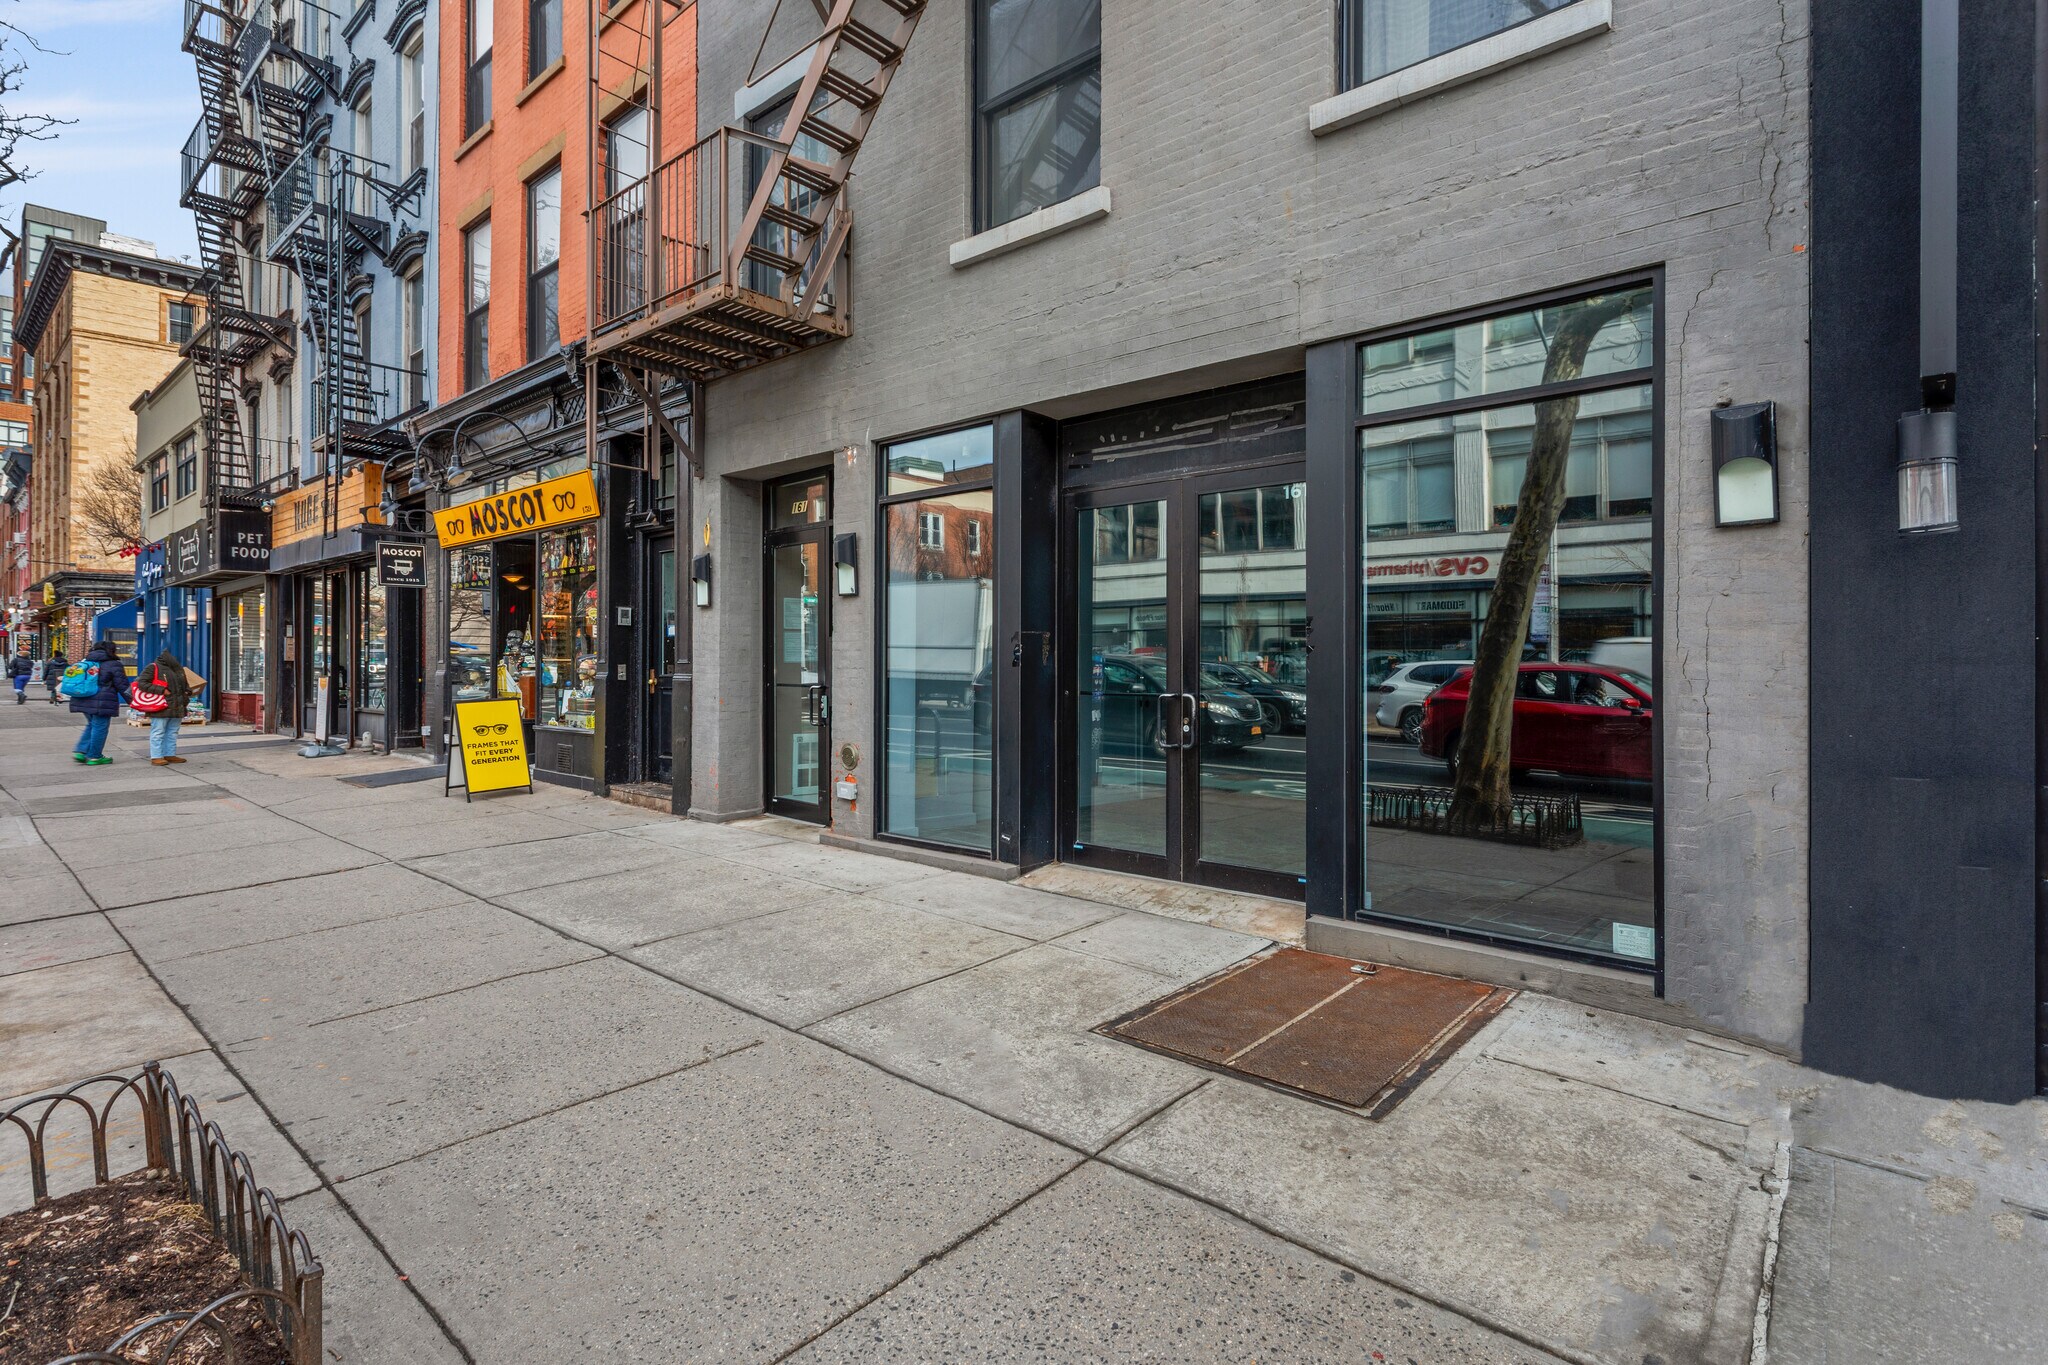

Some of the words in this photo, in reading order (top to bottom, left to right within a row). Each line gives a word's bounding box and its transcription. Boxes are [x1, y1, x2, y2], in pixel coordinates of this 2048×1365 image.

[294, 493, 320, 531] HUGE
[469, 489, 546, 536] MOSCOT
[793, 501, 807, 513] 161
[237, 532, 264, 544] PET
[231, 546, 269, 559] FOOD
[382, 547, 422, 557] MOSCOT
[467, 741, 499, 750] FRAMES
[489, 748, 514, 756] EVERY
[471, 755, 520, 765] GENERATION
